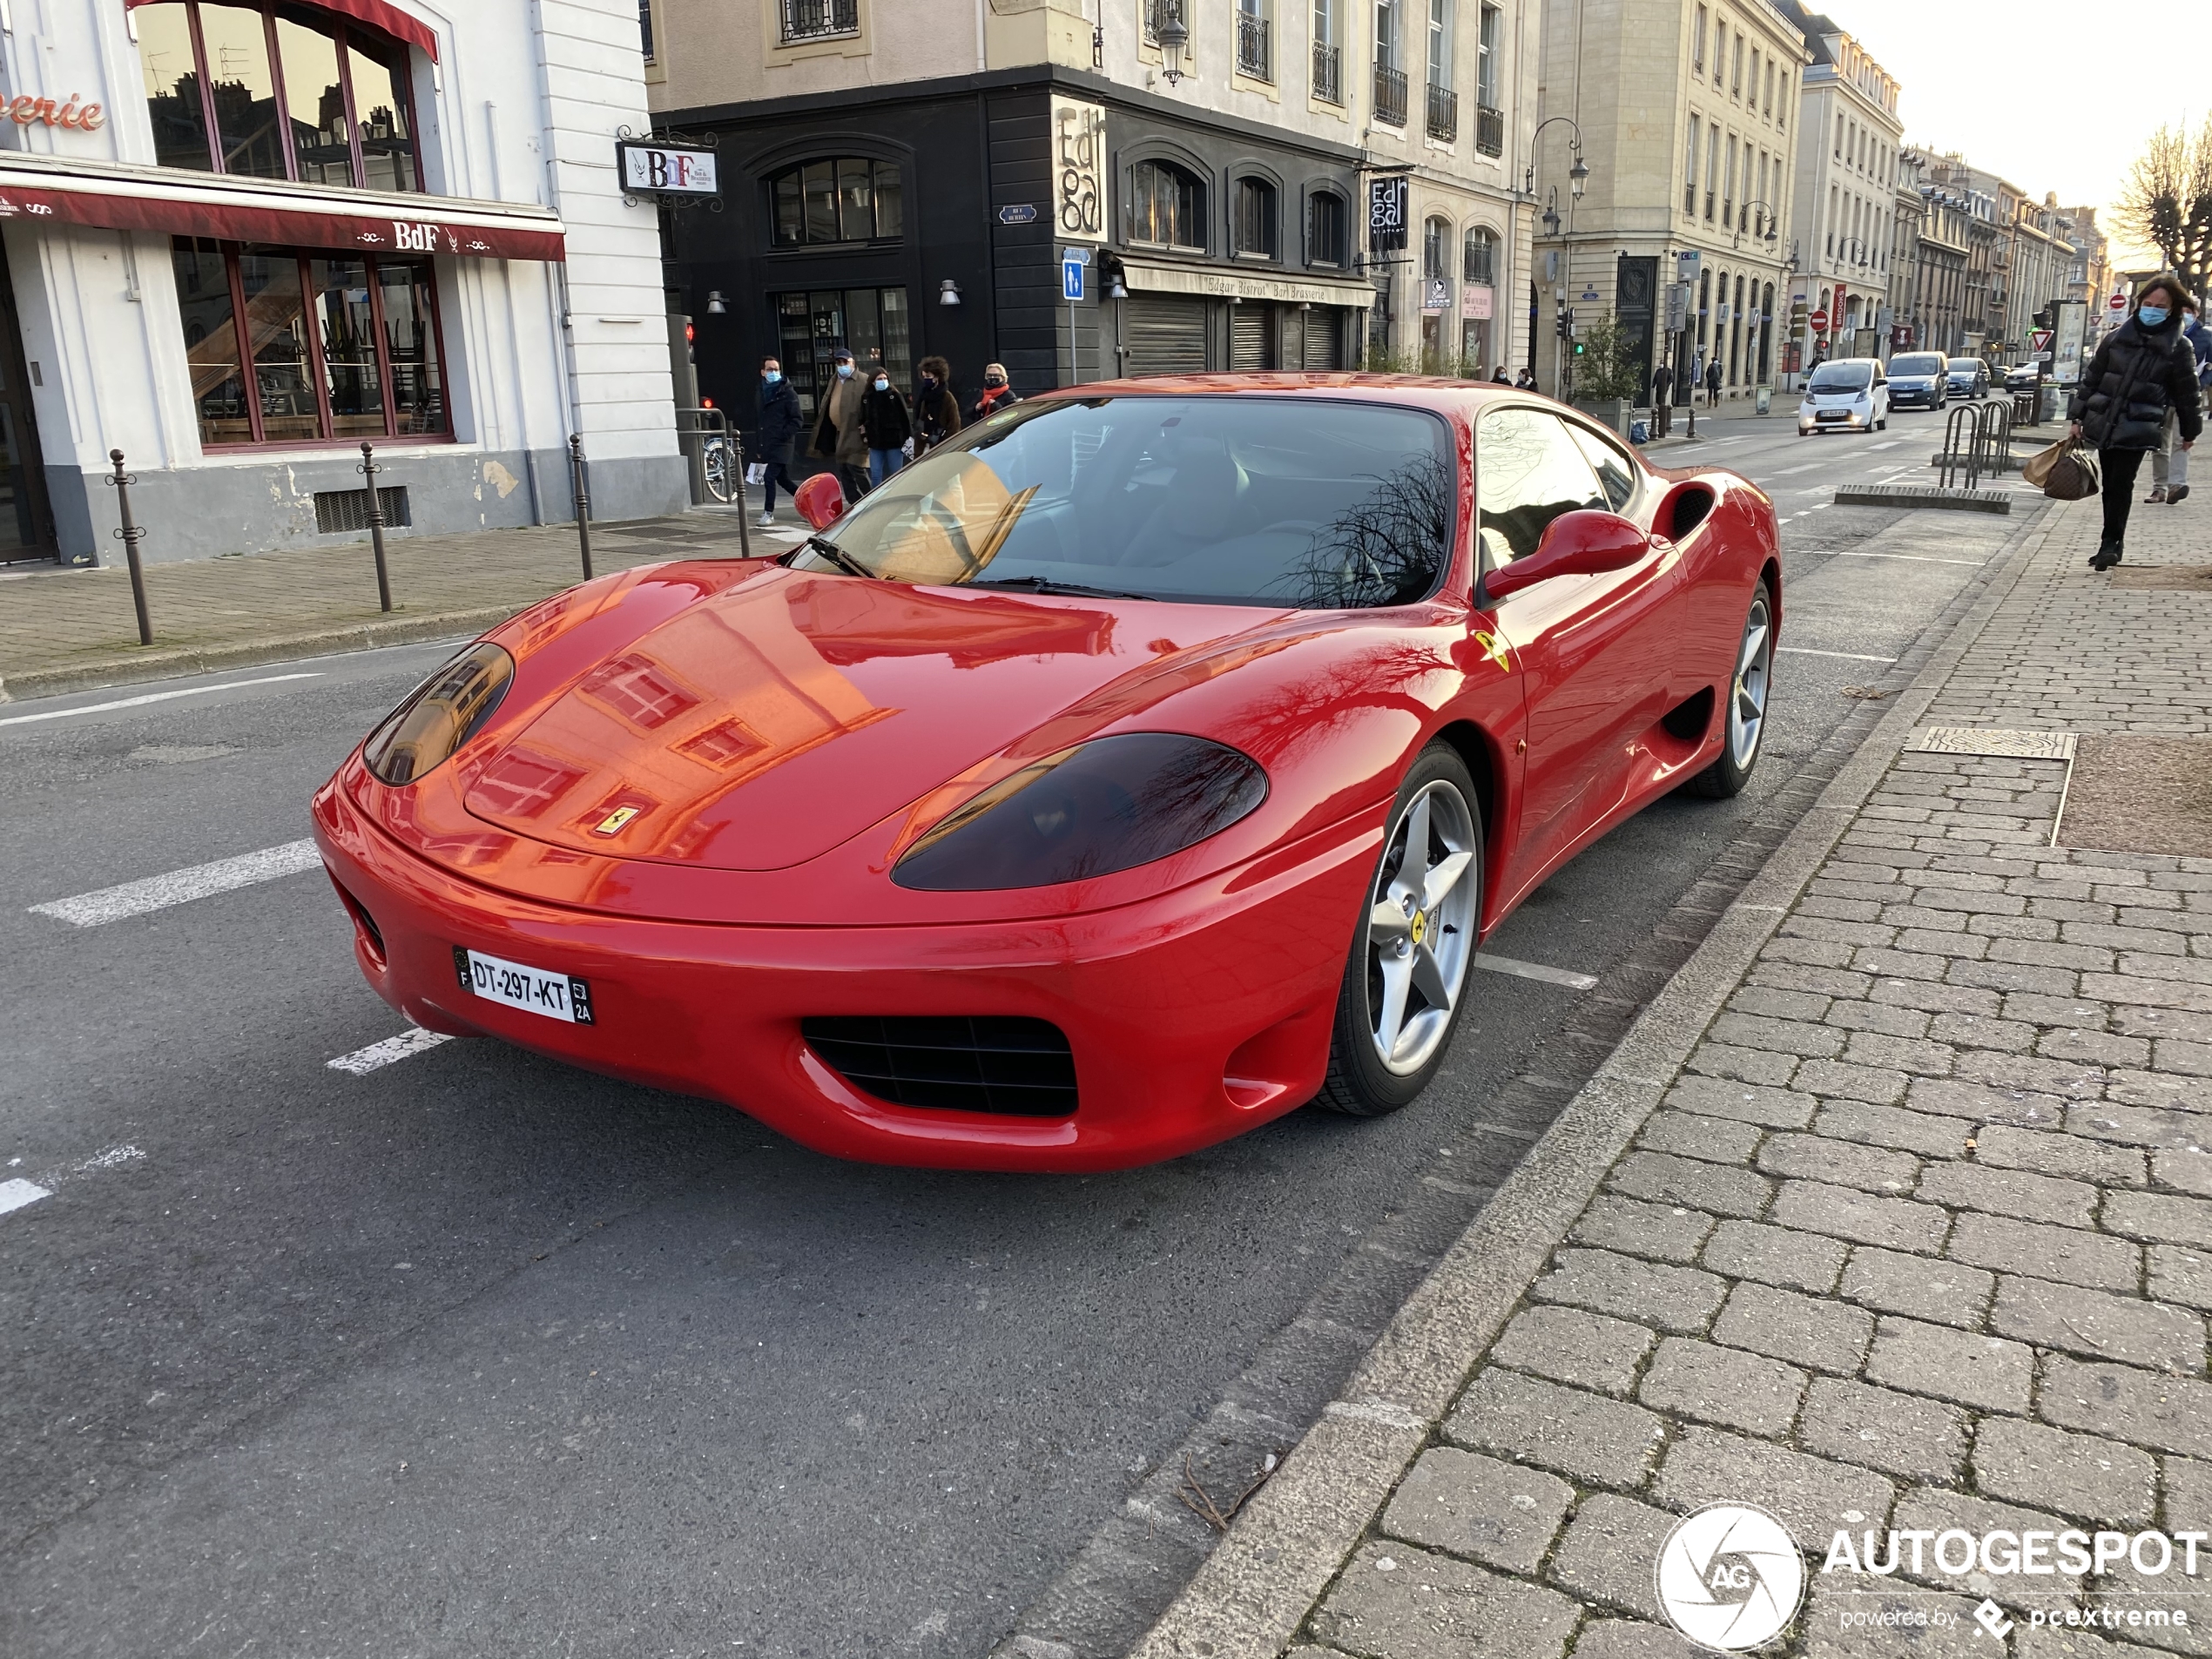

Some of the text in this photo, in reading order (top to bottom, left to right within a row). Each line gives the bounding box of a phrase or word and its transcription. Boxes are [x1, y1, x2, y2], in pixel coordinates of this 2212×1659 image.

[392, 221, 440, 252] BdF
[1291, 286, 1325, 300] Brasserie
[1836, 290, 1844, 325] BROOKS
[460, 972, 468, 985] F
[473, 960, 564, 1011] DT-297-KT
[575, 1003, 592, 1022] 2A
